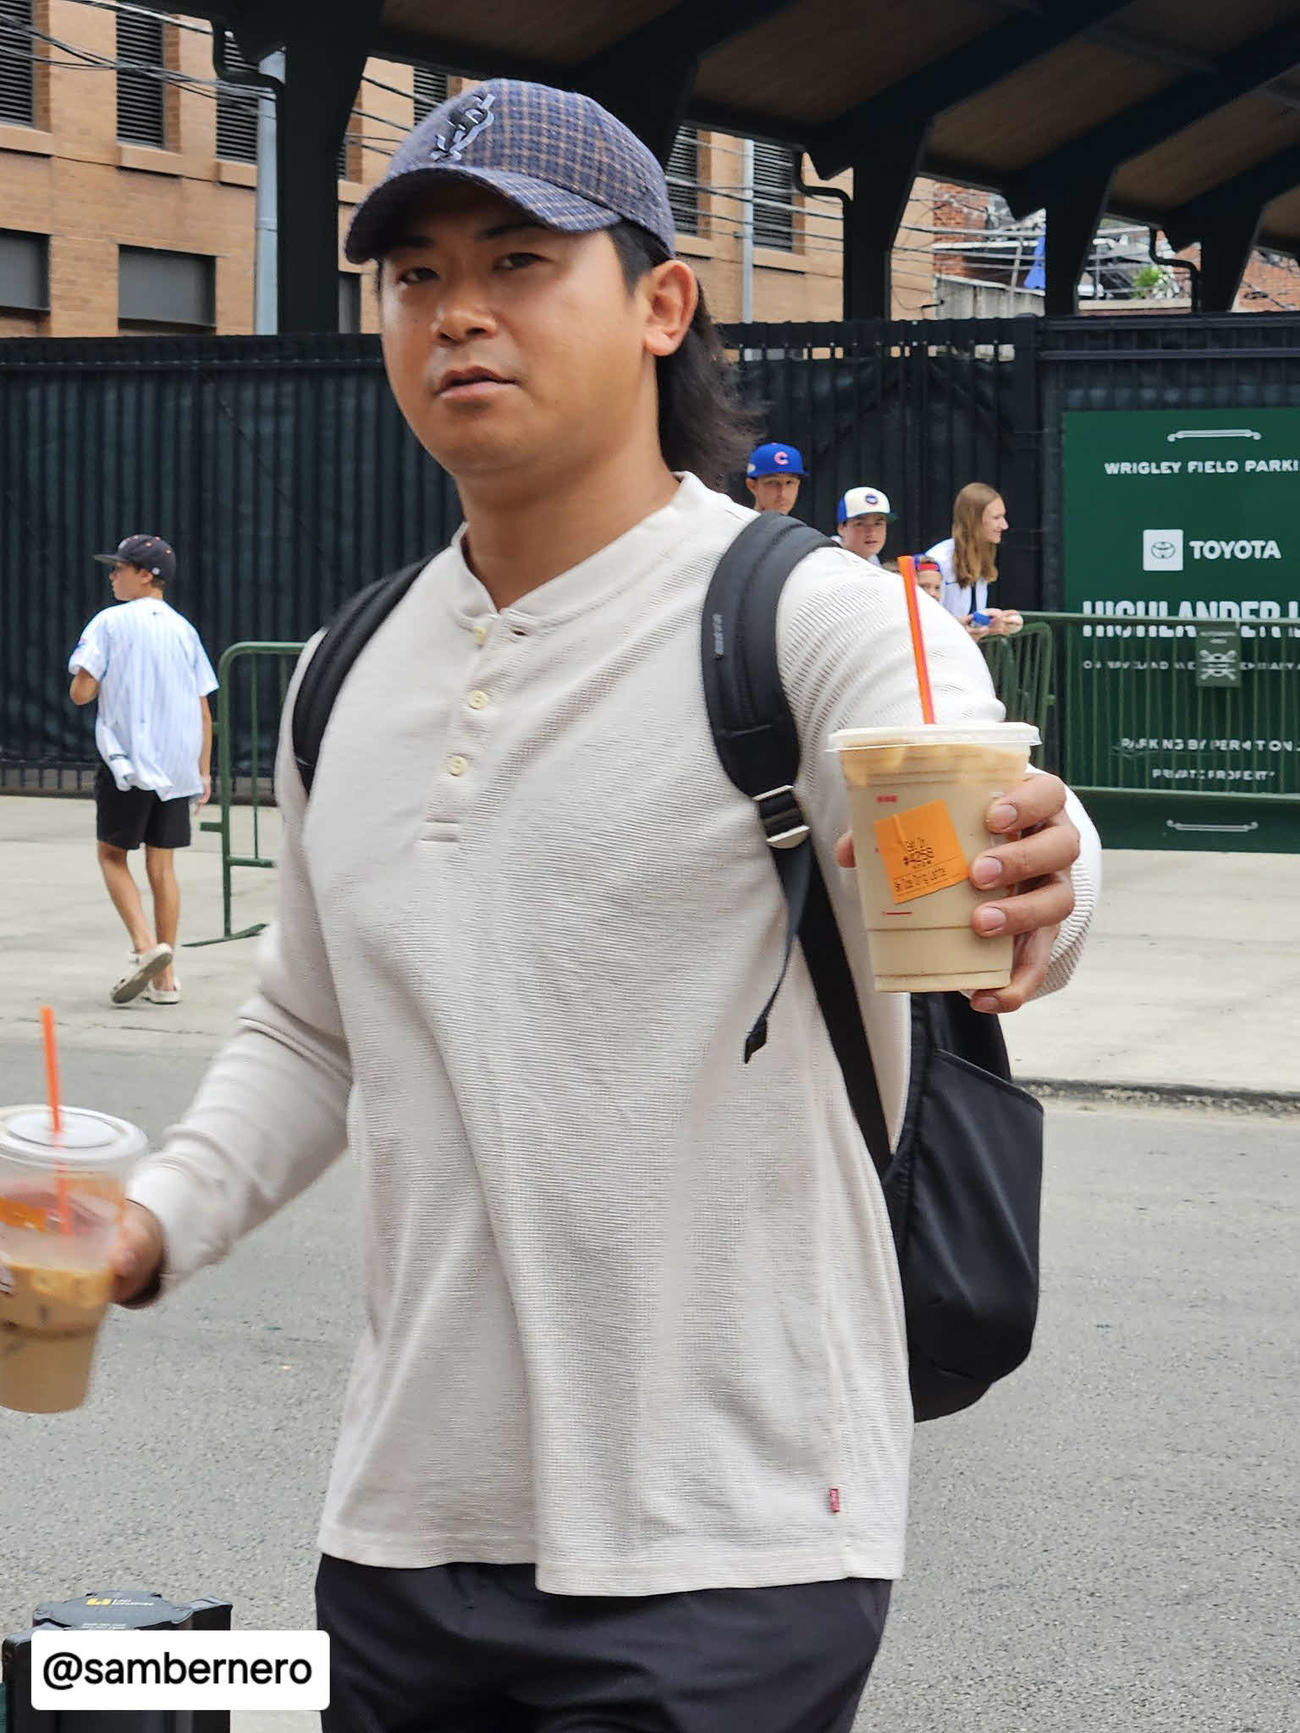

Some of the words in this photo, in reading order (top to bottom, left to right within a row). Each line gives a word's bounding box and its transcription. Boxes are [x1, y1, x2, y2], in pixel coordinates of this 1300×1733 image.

[774, 451, 789, 465] C
[1104, 462, 1181, 475] WRIGLEY
[1188, 461, 1239, 473] FIELD
[1189, 540, 1282, 560] TOYOTA
